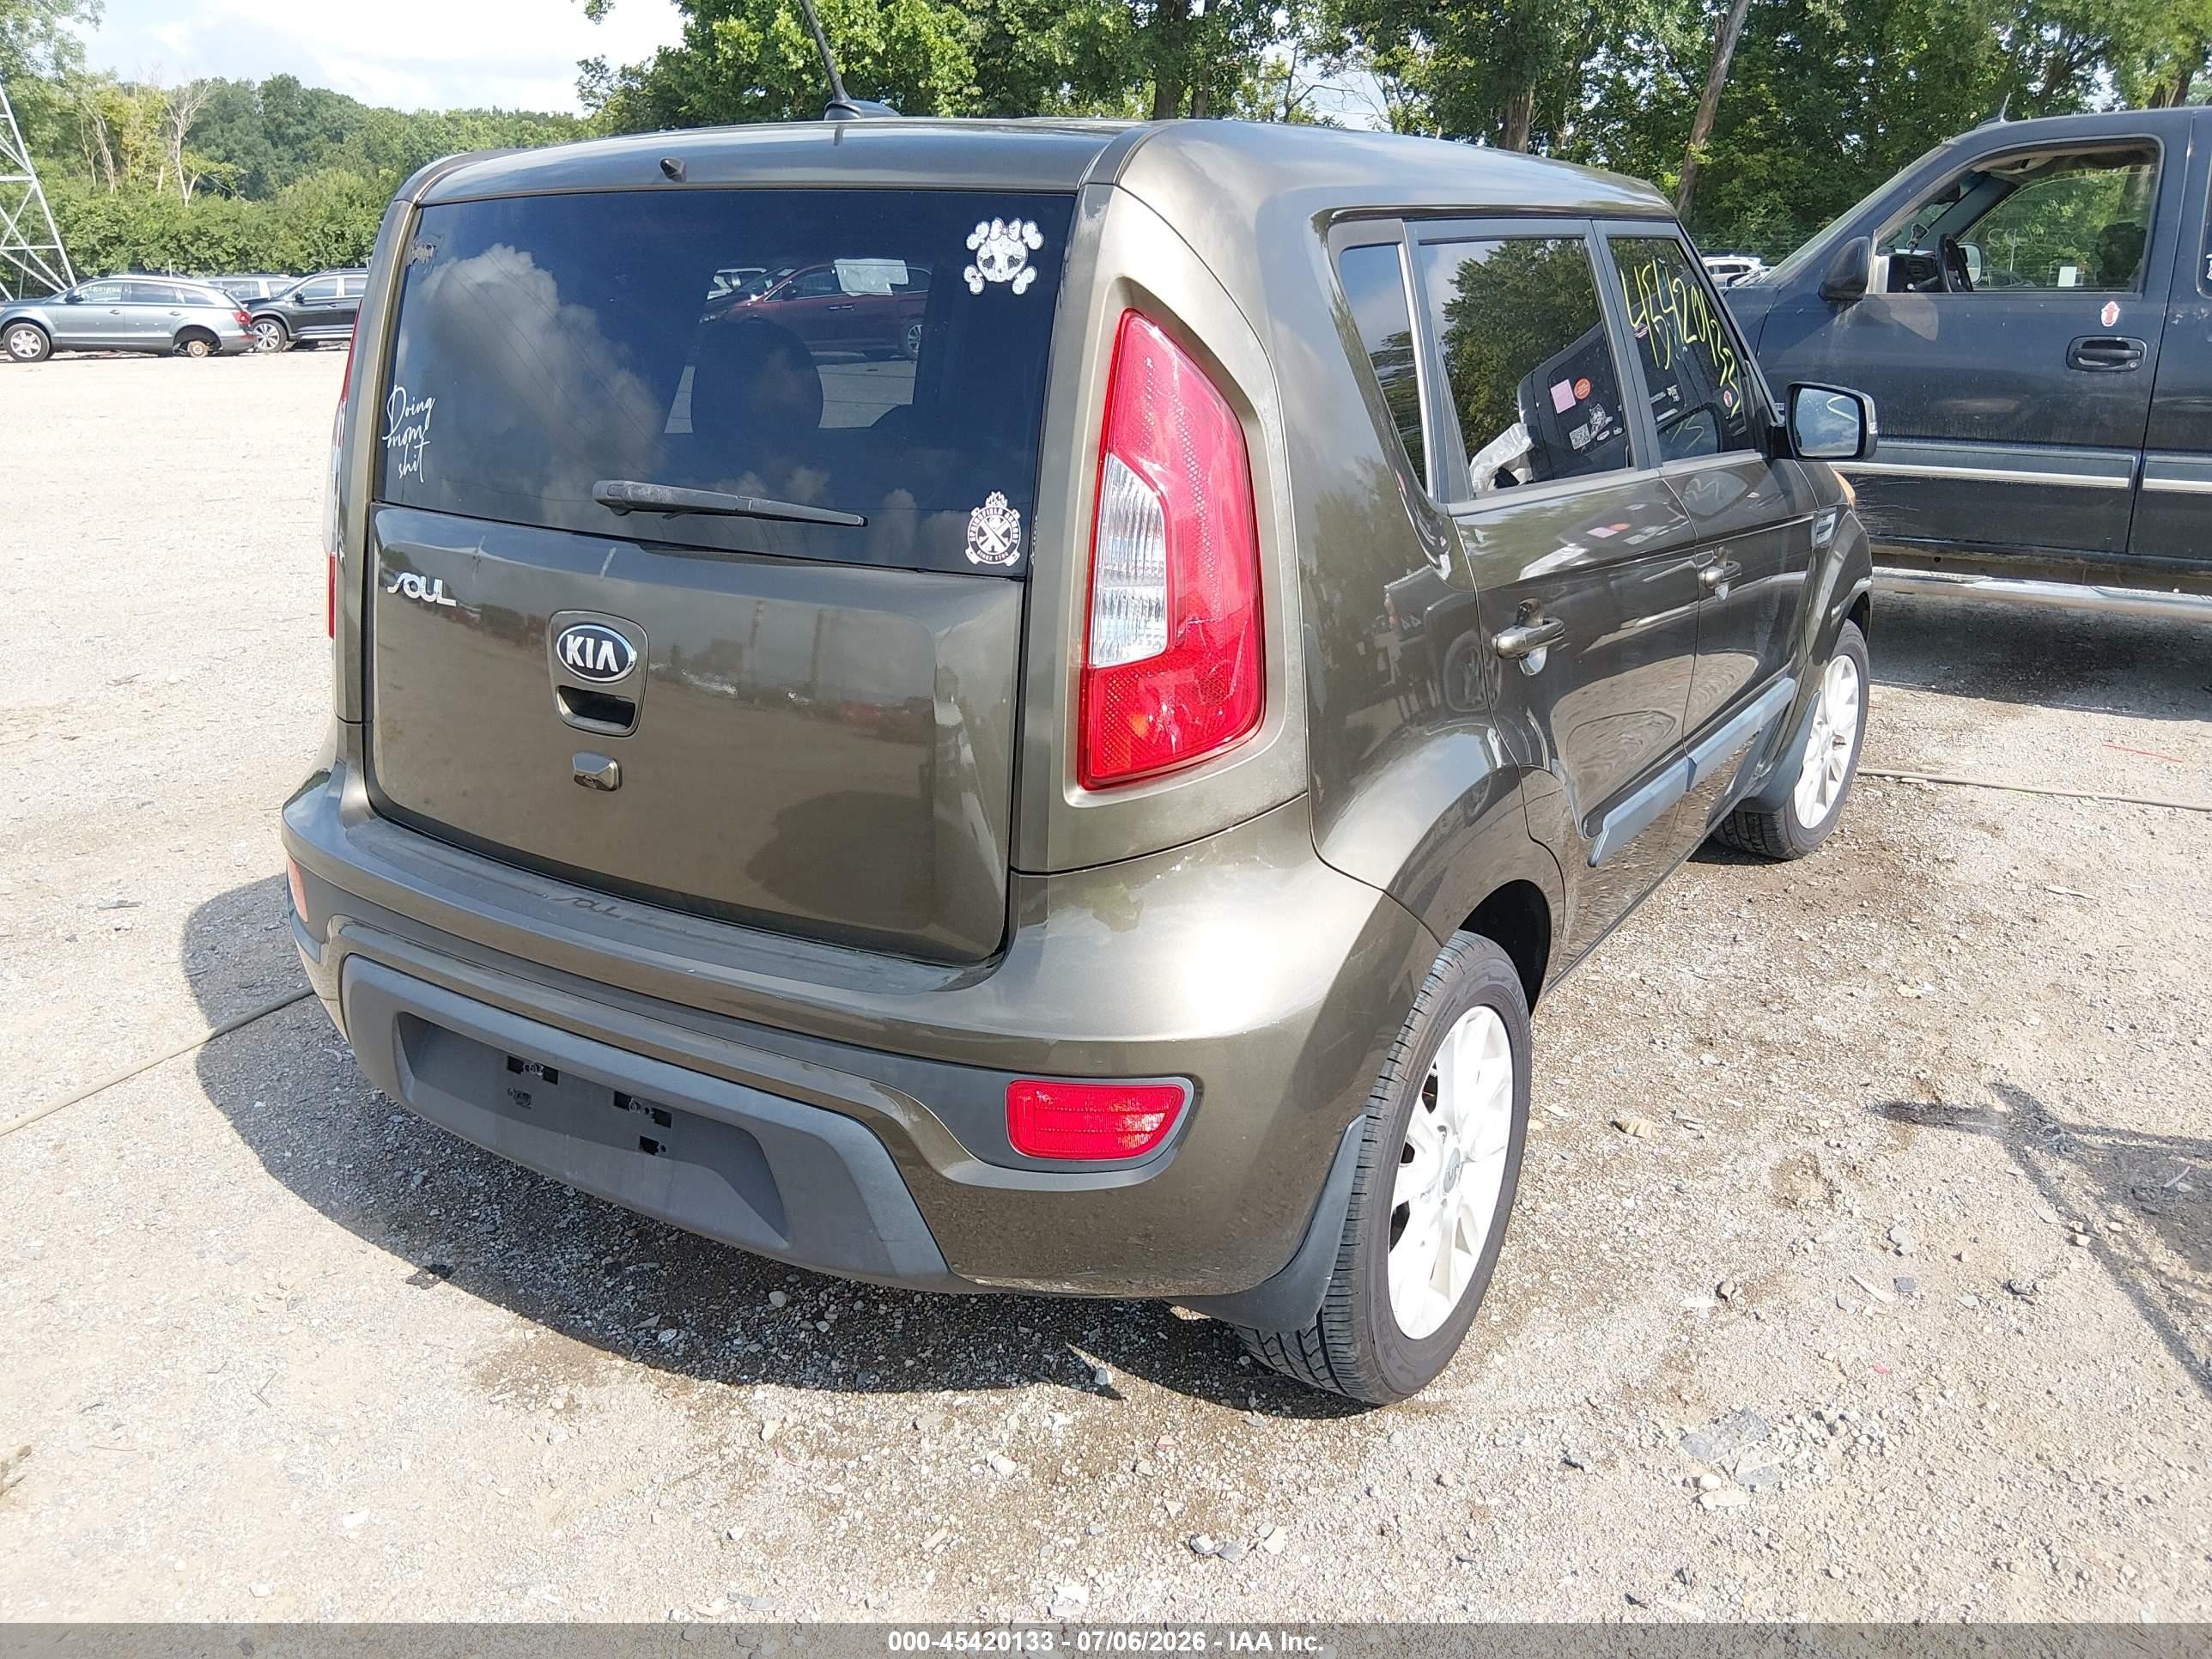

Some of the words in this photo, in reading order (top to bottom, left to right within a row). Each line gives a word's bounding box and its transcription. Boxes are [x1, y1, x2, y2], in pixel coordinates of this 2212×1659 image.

[382, 384, 436, 441] Doing
[387, 425, 423, 448] mom
[398, 440, 430, 483] shit
[387, 572, 457, 607] SOUL
[567, 635, 619, 672] KIA
